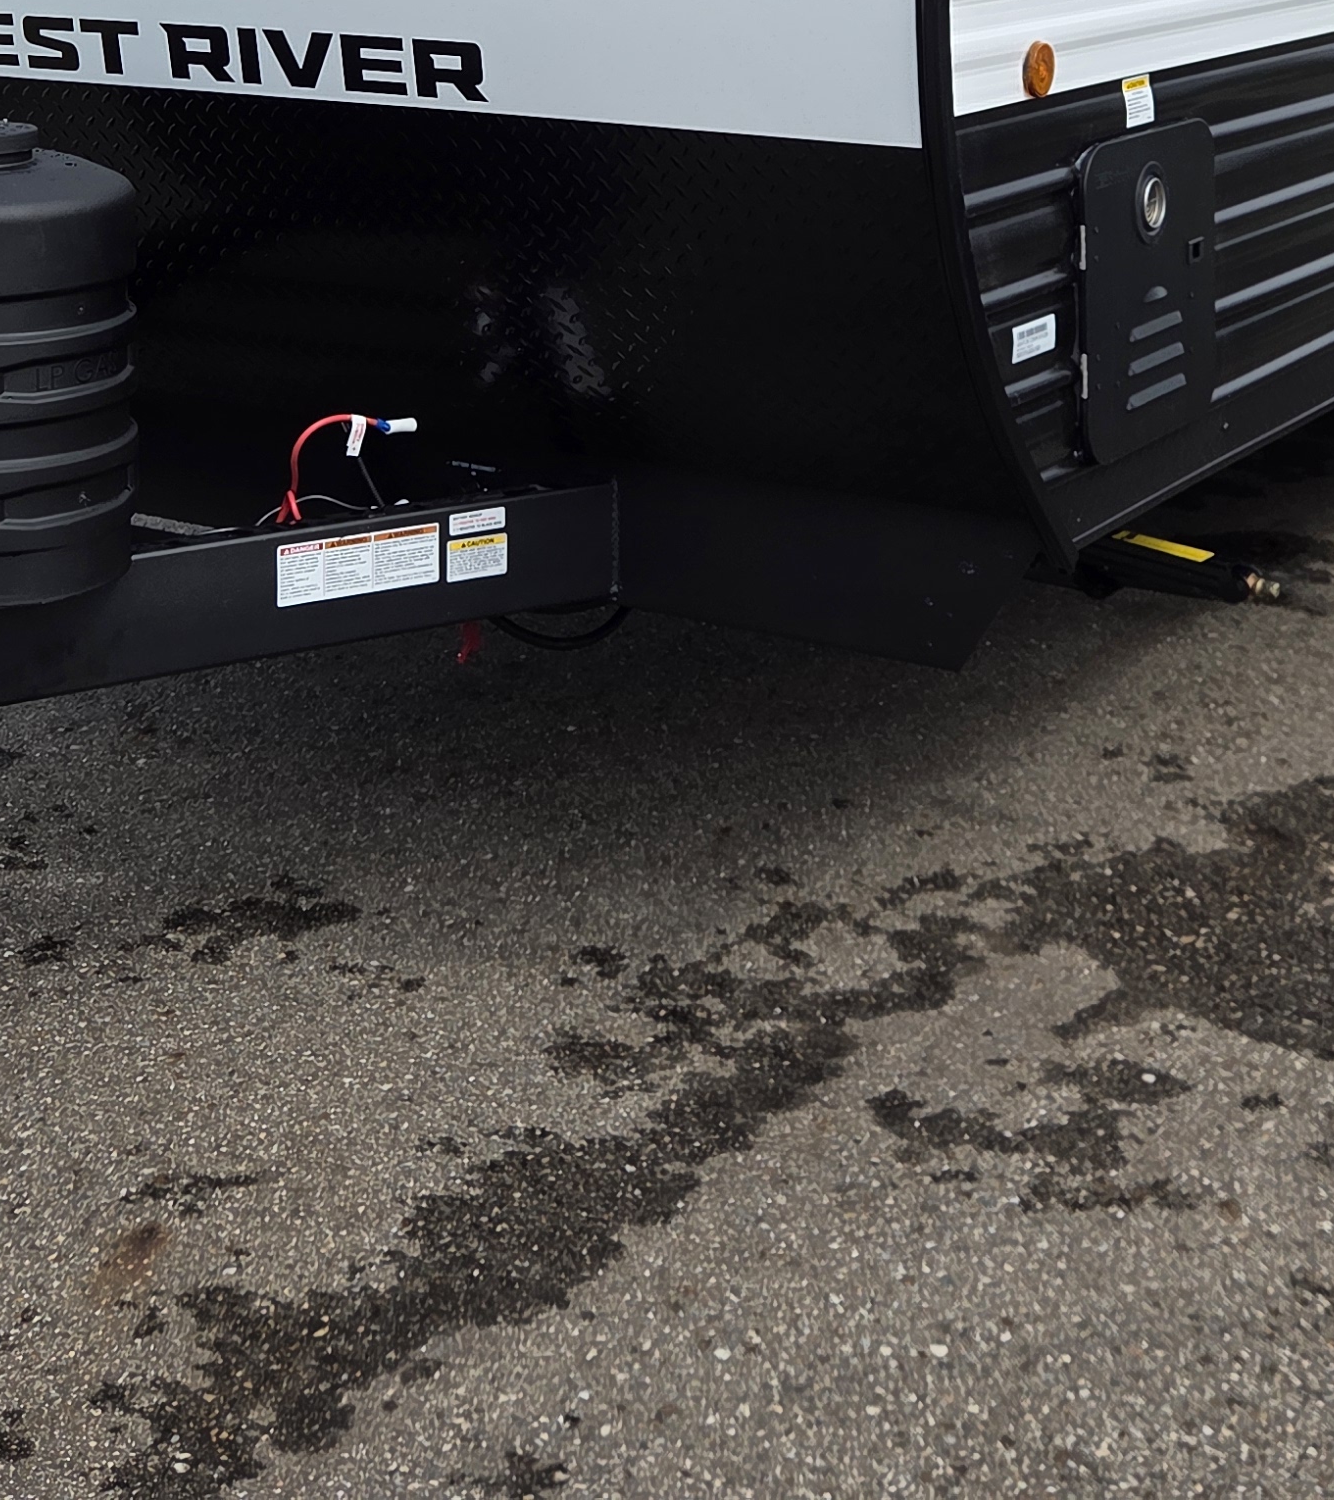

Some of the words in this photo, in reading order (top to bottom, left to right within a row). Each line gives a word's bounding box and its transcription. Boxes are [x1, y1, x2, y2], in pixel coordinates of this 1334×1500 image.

[158, 21, 490, 103] RIVER
[35, 365, 65, 392] LP
[289, 542, 321, 554] DANGER
[466, 537, 495, 548] CAUTION
